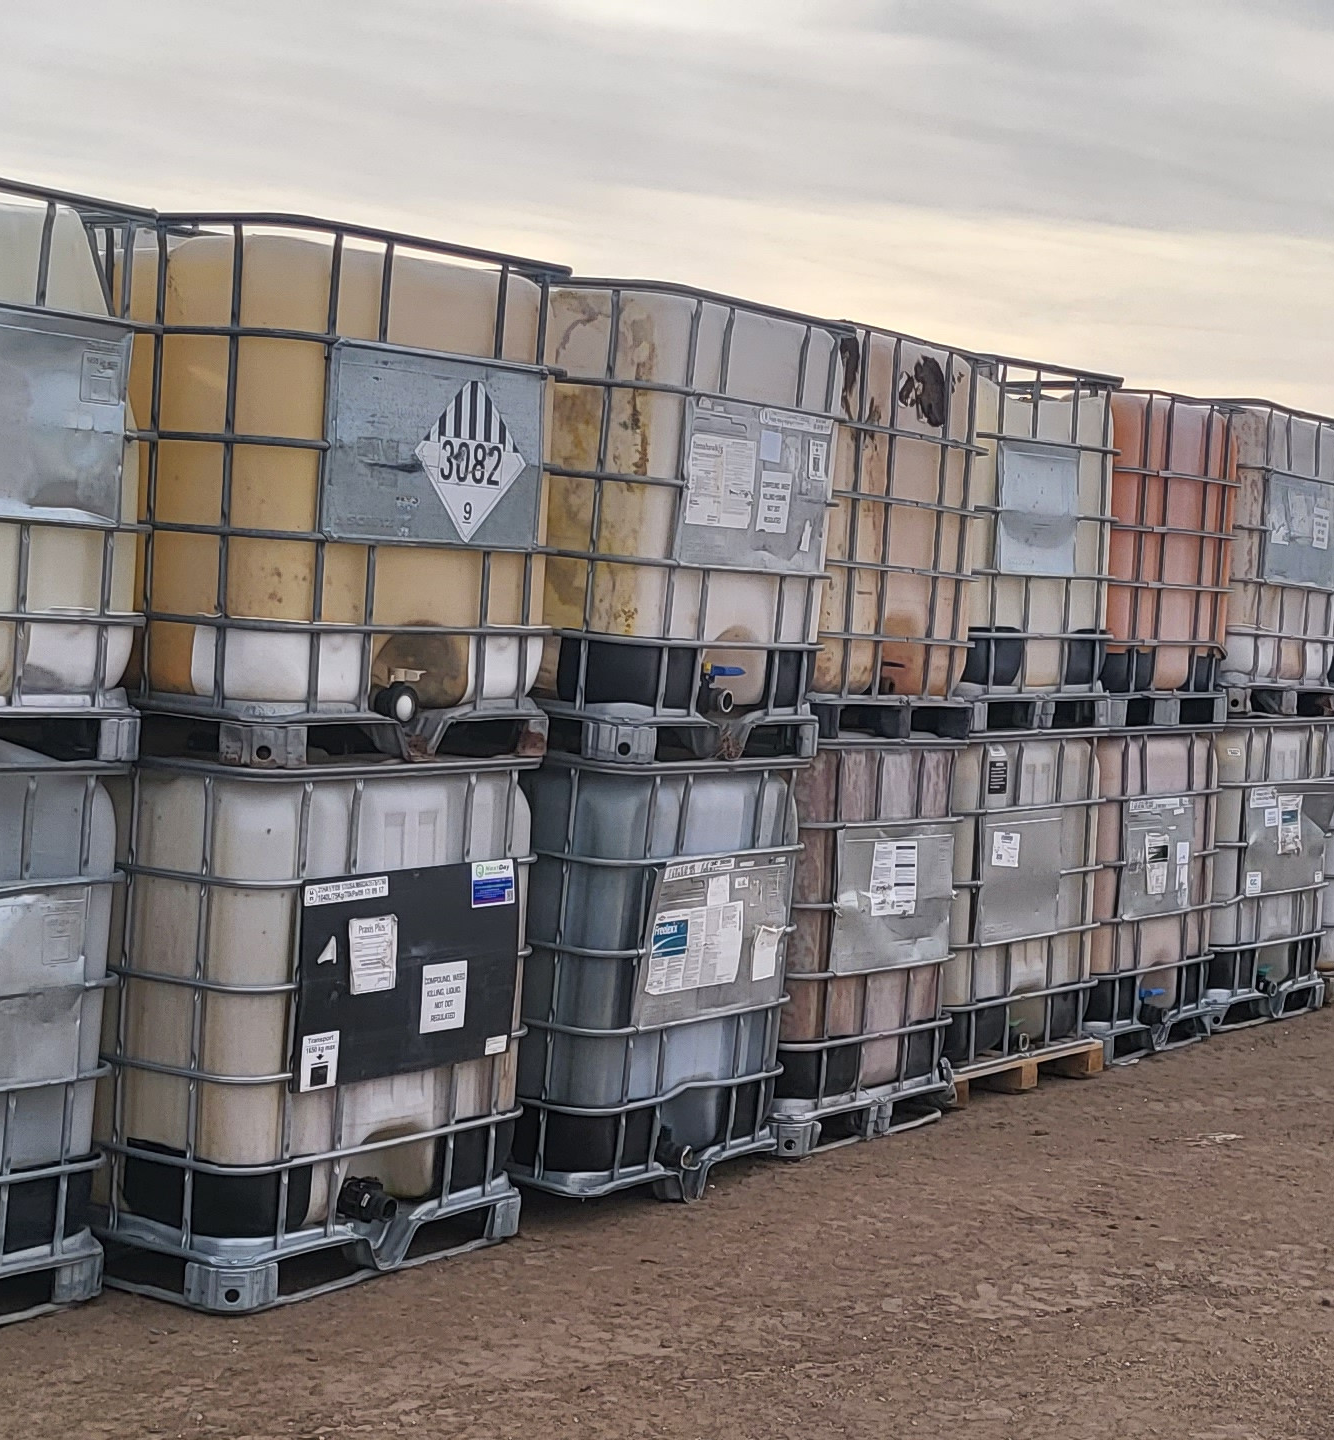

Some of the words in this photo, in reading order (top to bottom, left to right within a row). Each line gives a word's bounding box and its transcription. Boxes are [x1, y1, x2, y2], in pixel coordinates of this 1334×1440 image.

[440, 440, 502, 486] 3082
[463, 502, 472, 520] 9
[308, 1035, 334, 1044] Transport
